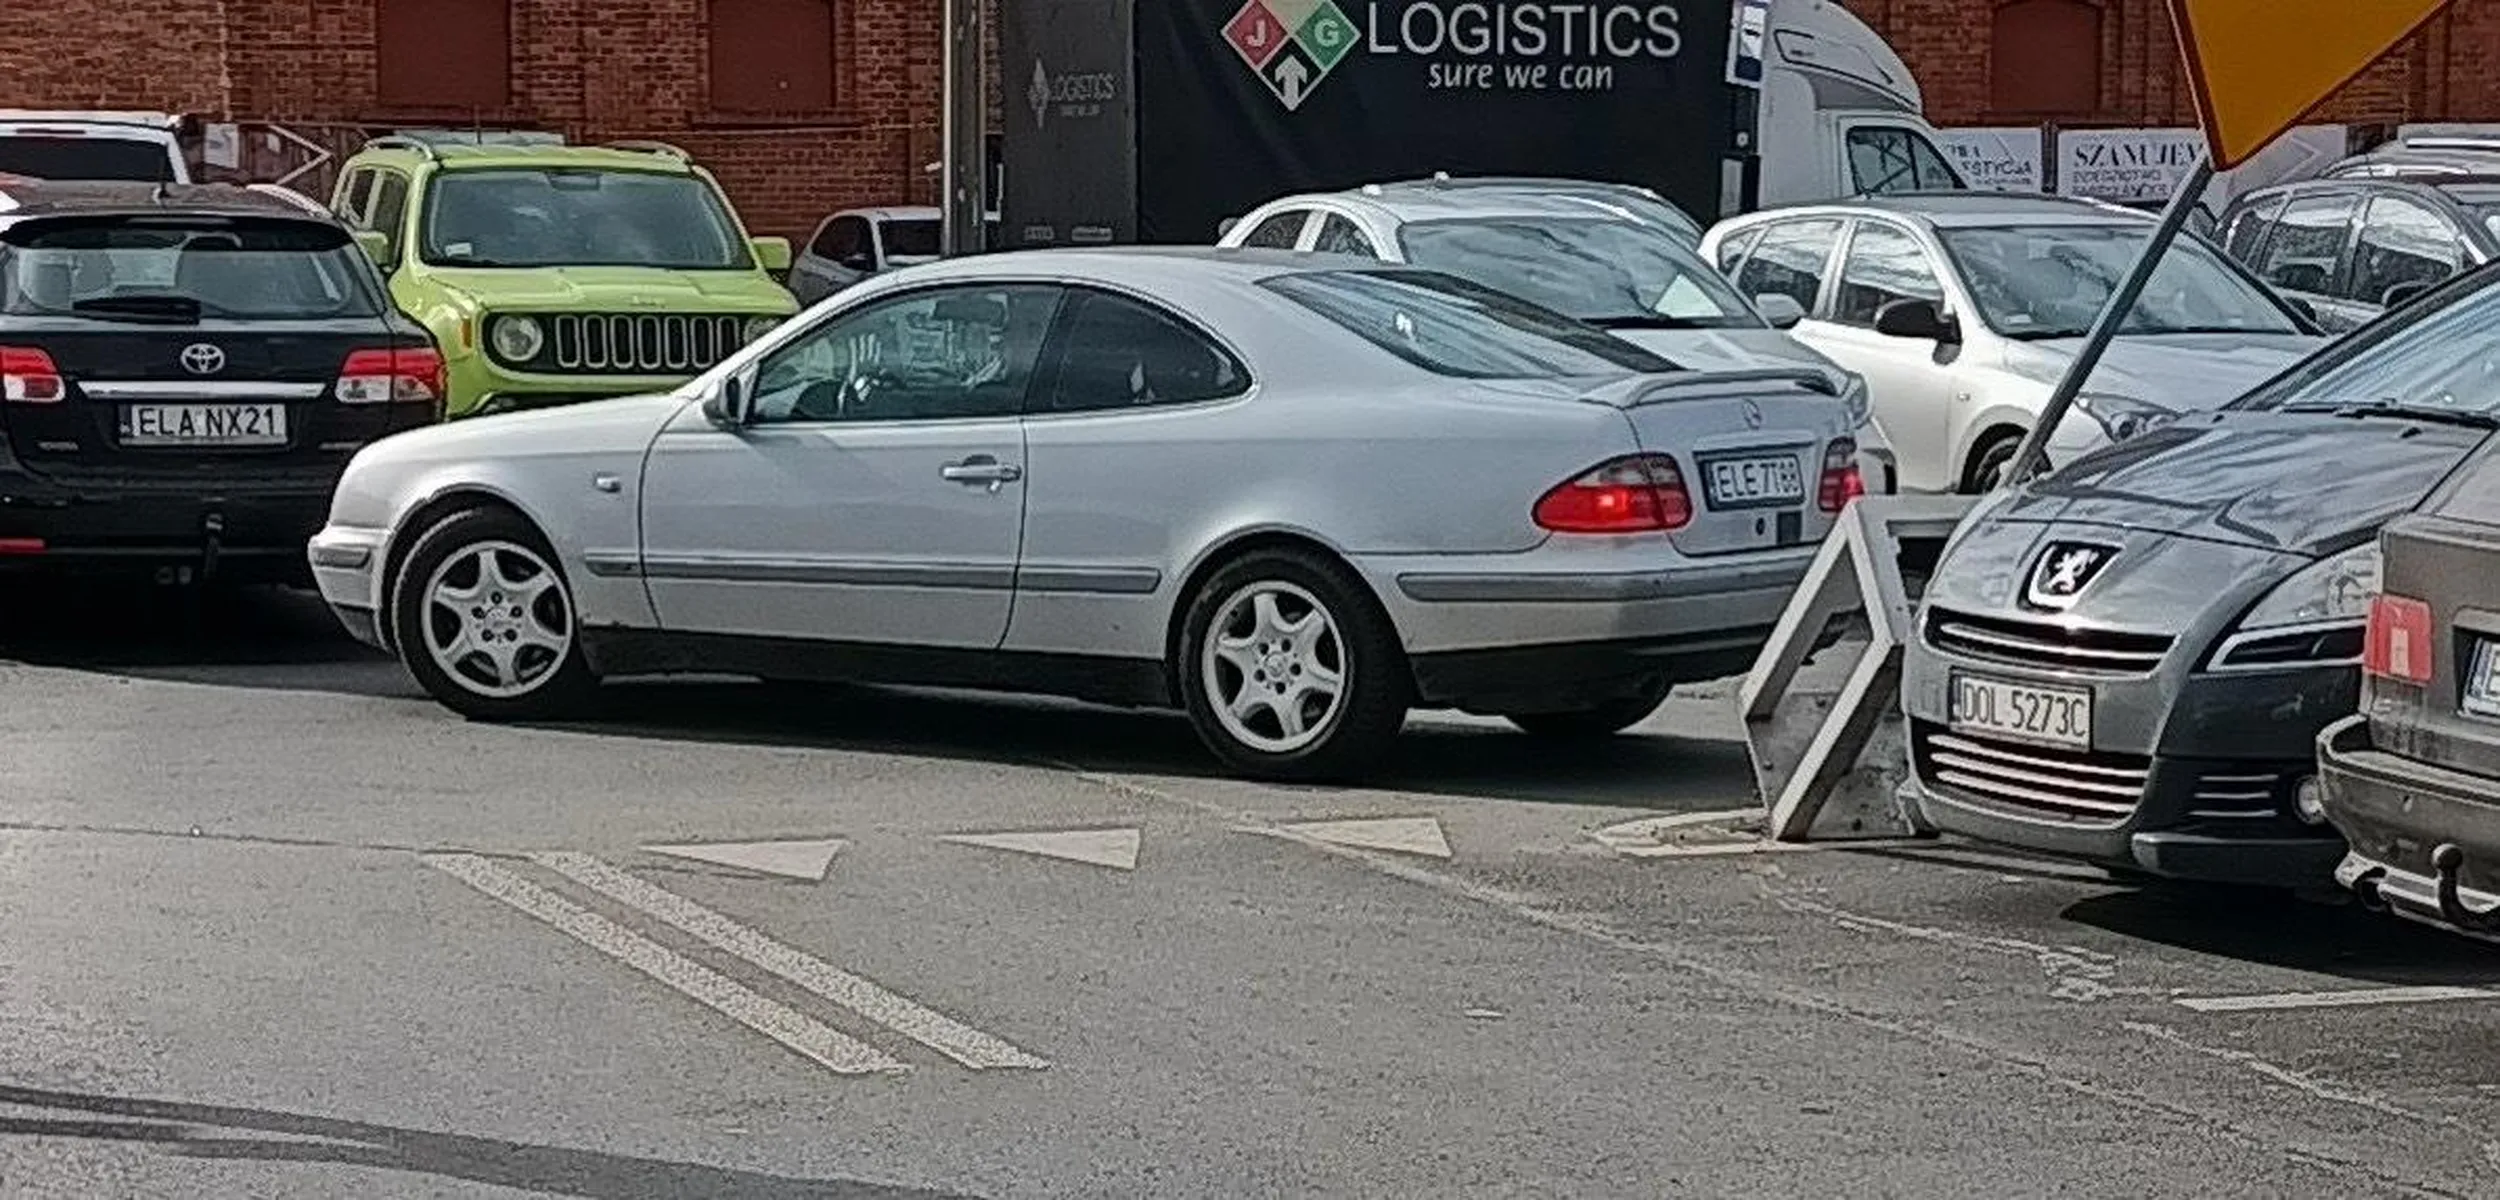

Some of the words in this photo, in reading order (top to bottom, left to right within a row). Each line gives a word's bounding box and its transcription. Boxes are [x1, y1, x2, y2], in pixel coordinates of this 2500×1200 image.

[1243, 19, 1266, 47] J
[1314, 18, 1340, 47] G
[1368, 1, 1682, 57] LOGISTICS
[1428, 62, 1493, 90] sure
[1505, 64, 1548, 89] we
[1558, 64, 1614, 90] can
[139, 407, 196, 436] ELA
[205, 407, 275, 436] NX21
[1963, 682, 2004, 726] DOL
[2011, 689, 2087, 738] 5273C
